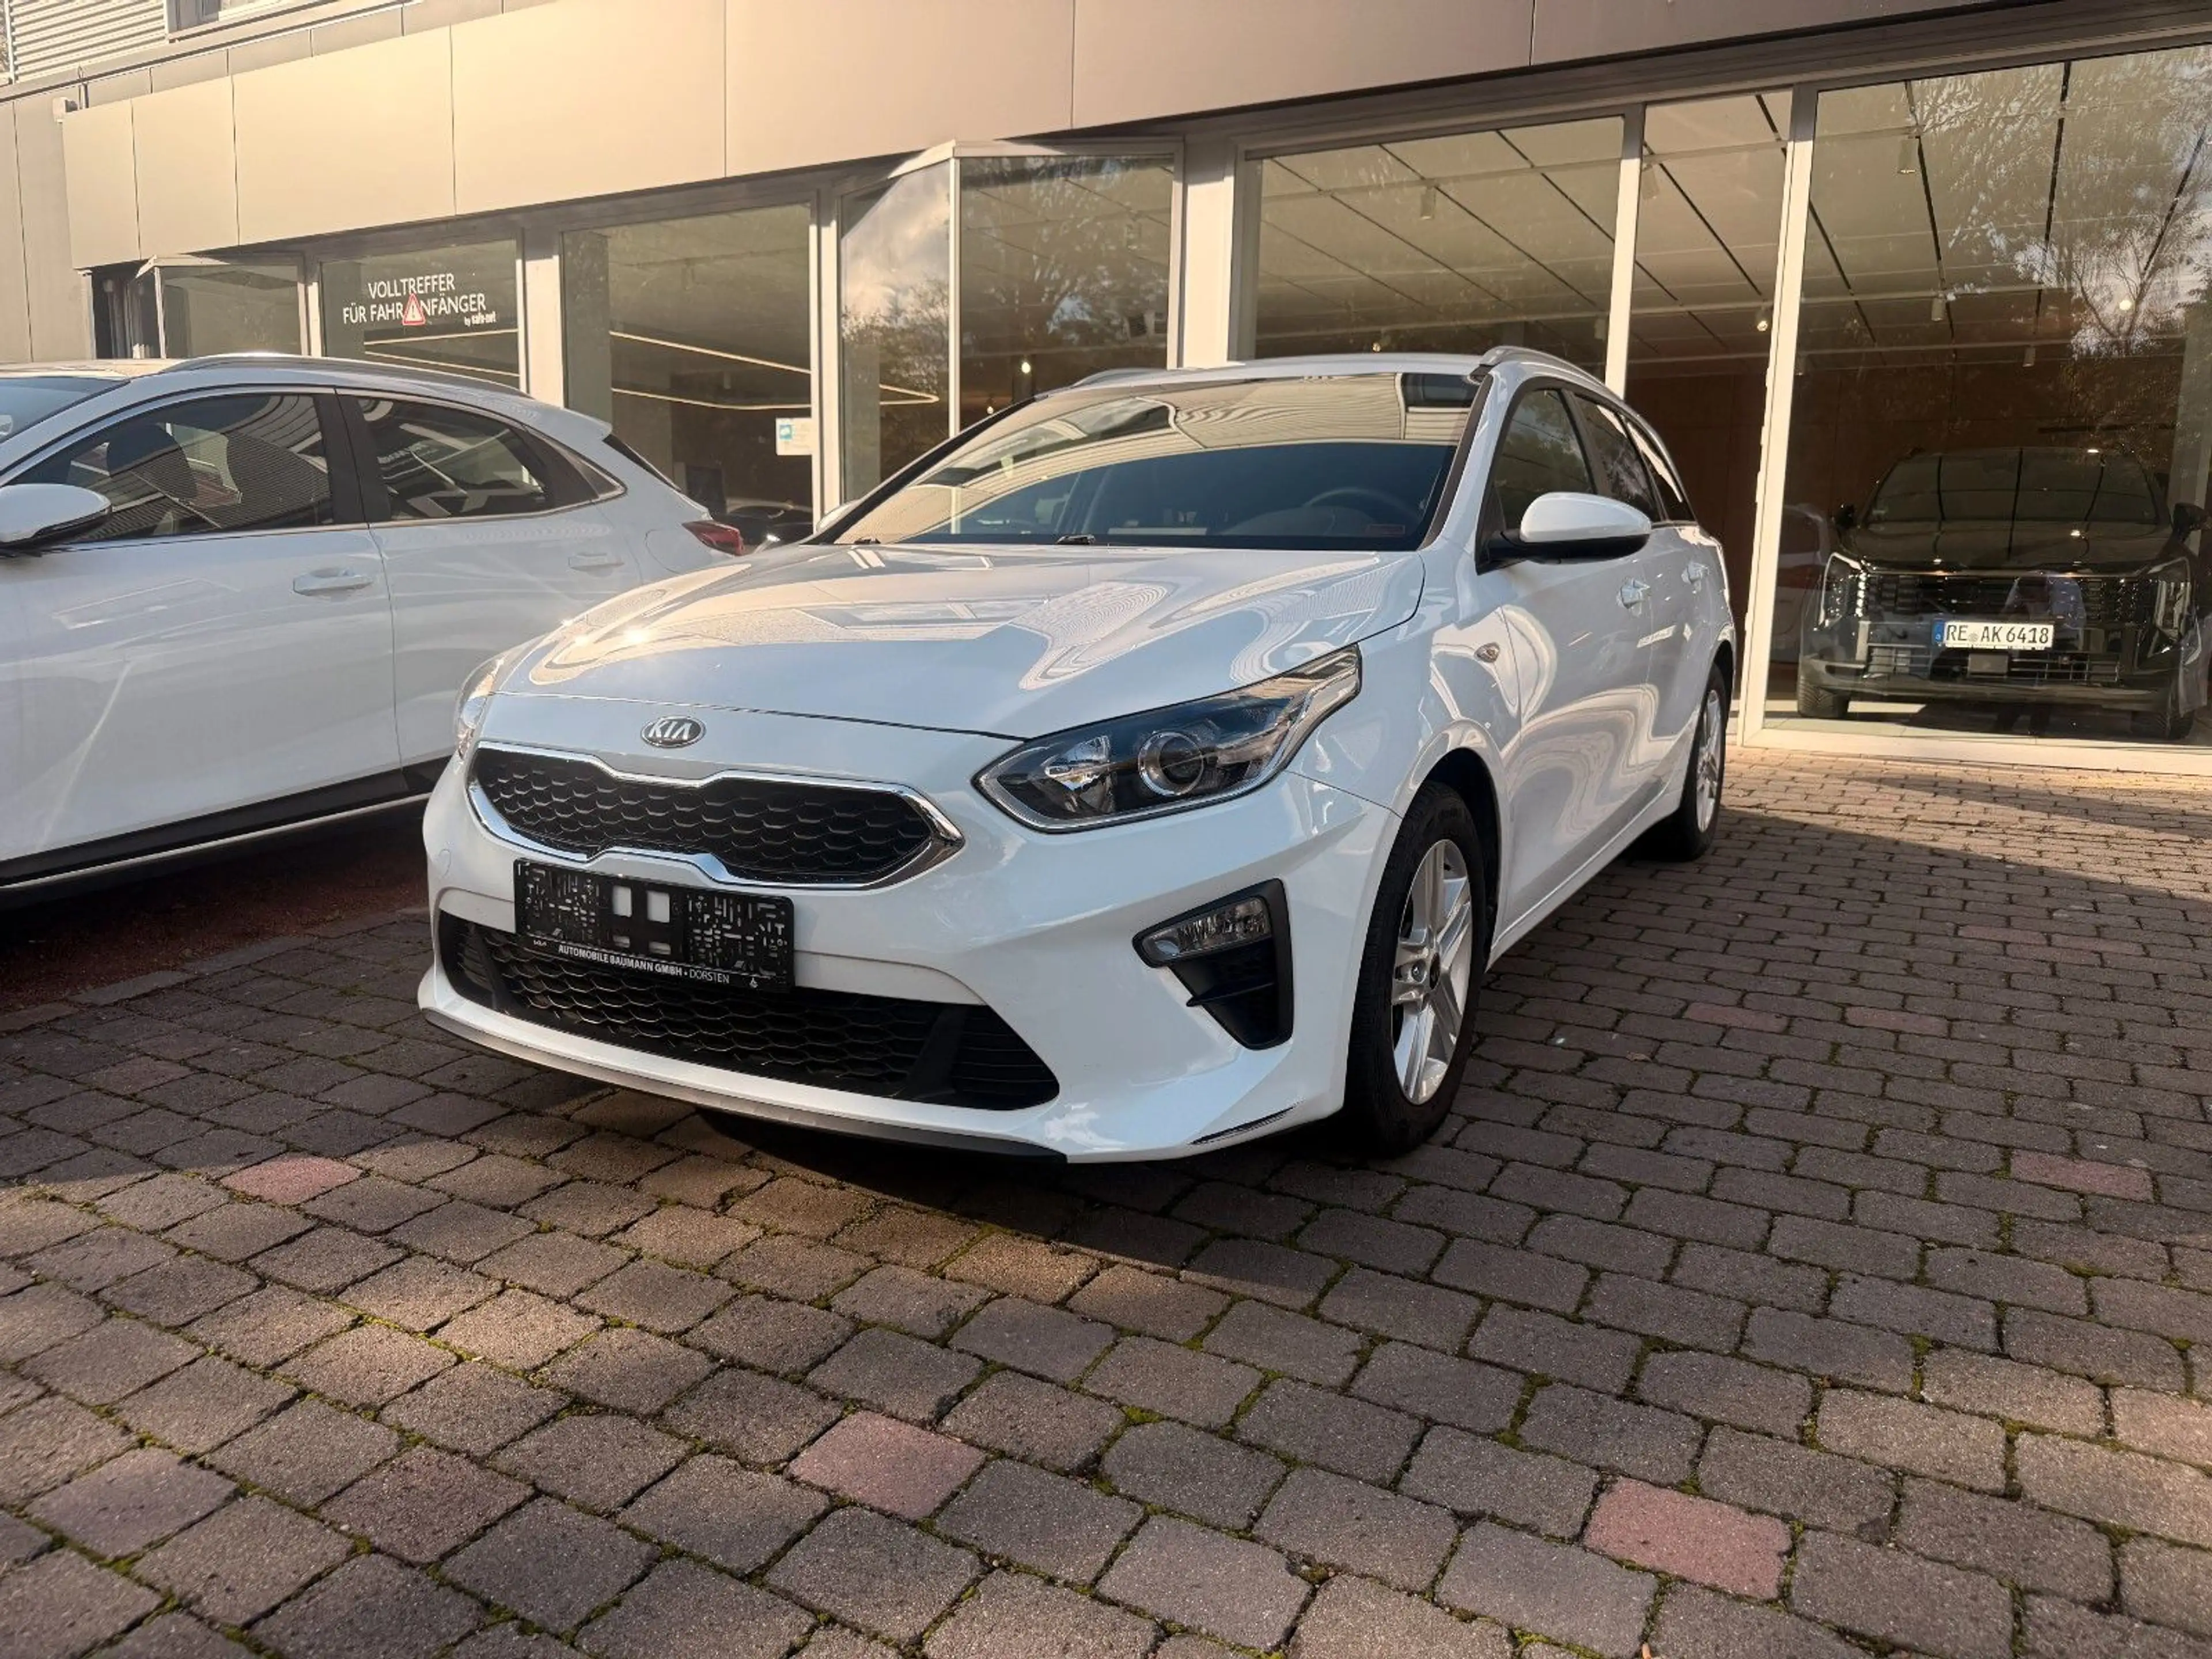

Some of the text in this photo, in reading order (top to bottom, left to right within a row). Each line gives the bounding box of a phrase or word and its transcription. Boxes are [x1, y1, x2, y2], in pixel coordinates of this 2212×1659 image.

[368, 273, 455, 299] VOLLTREFFER
[343, 303, 367, 324] FÜR
[1946, 625, 1968, 641] RE
[1980, 626, 2003, 642] AK
[2006, 627, 2049, 644] 6418
[648, 719, 692, 740] KIA
[558, 944, 609, 964] AUTOMOBILE
[609, 955, 654, 972] BAUMANN
[689, 969, 730, 984] DORSTEN
